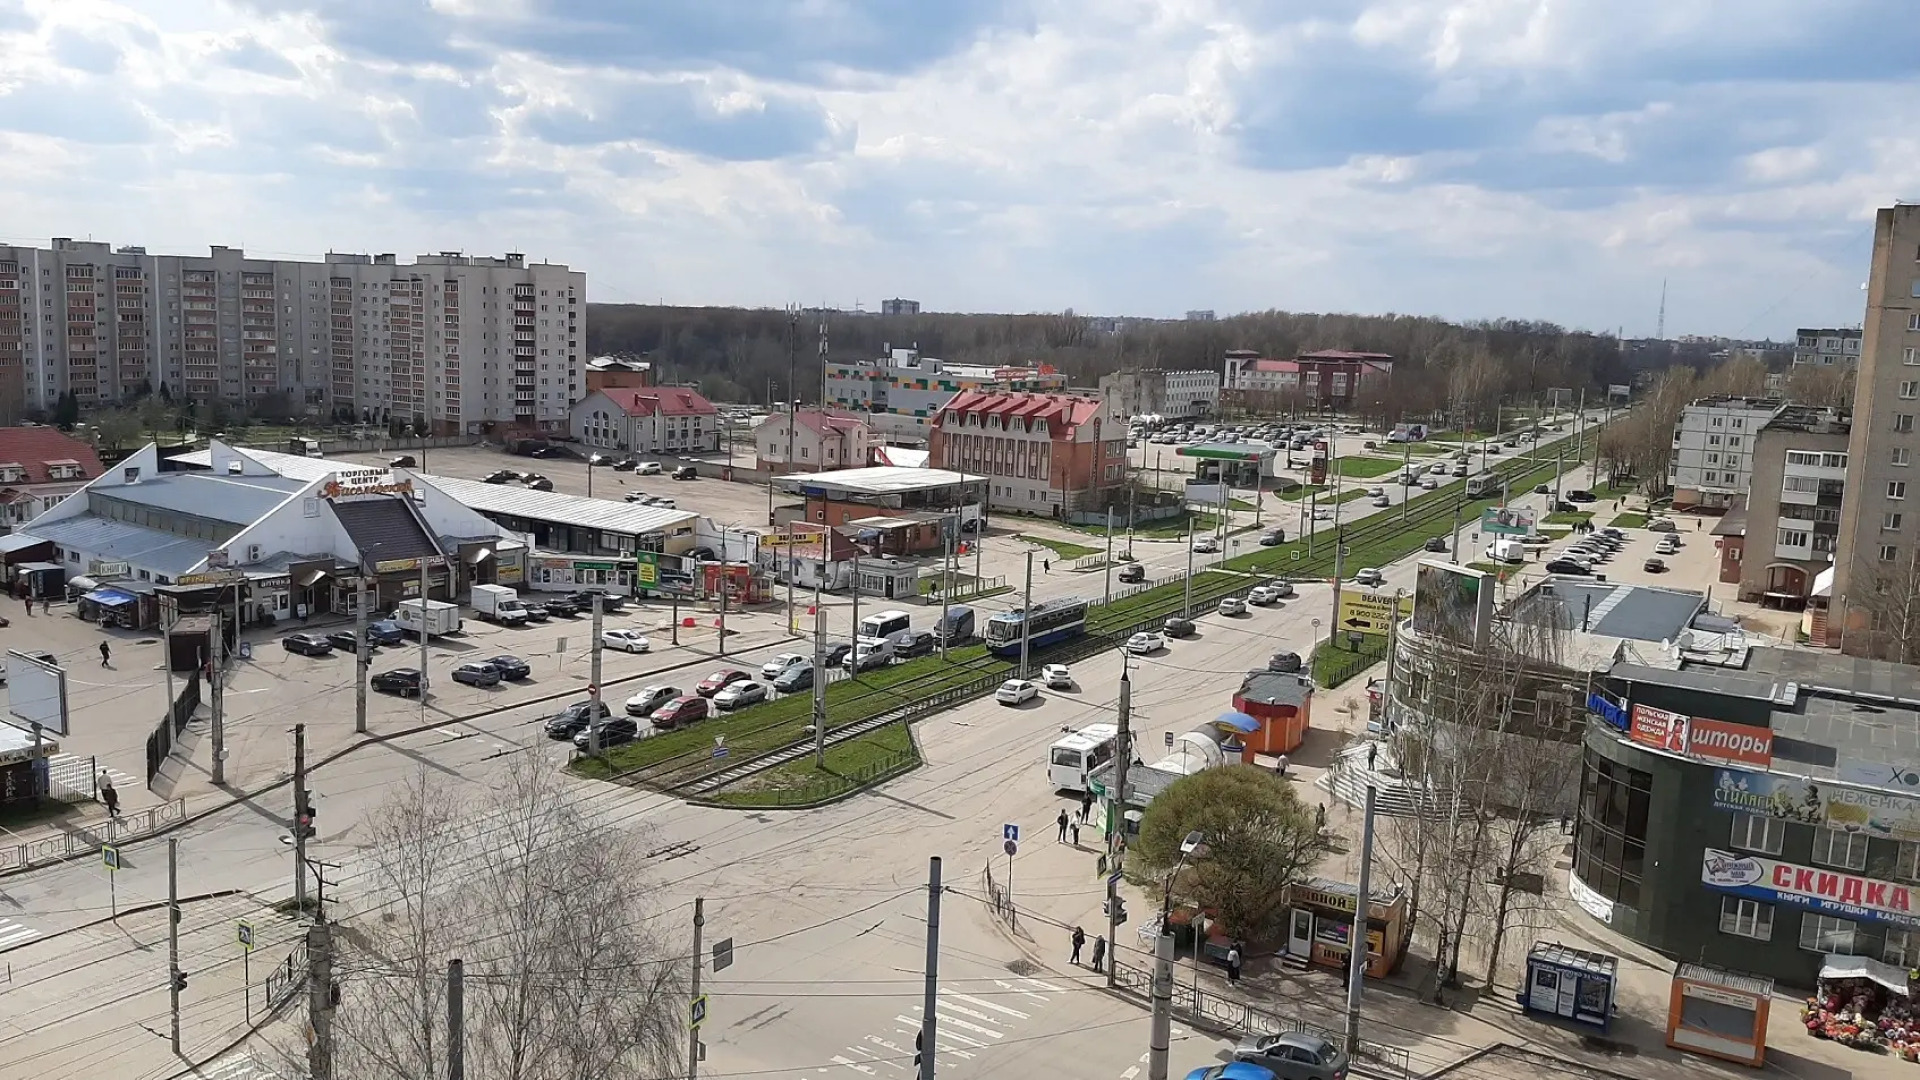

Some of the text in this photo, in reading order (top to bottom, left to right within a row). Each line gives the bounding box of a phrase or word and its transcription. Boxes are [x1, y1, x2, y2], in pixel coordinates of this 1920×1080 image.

[341, 464, 389, 478] ТОРГОВЫЙ
[351, 476, 380, 485] ЦЕНТР
[101, 563, 127, 574] КНИГИ
[1636, 706, 1669, 720] ПОЛЬСКАЯ
[1637, 715, 1667, 727] ЖЕНСКАЯ
[1636, 723, 1665, 736] ОДЕЖДА
[1692, 727, 1771, 757] шторы
[1832, 790, 1914, 812] НЕЖЕНКА
[1772, 864, 1911, 912] СКИДКА
[1776, 891, 1810, 905] КНИГИ
[1820, 899, 1869, 916] ИГРУШКИ
[1876, 910, 1920, 926] КАНЦТО
